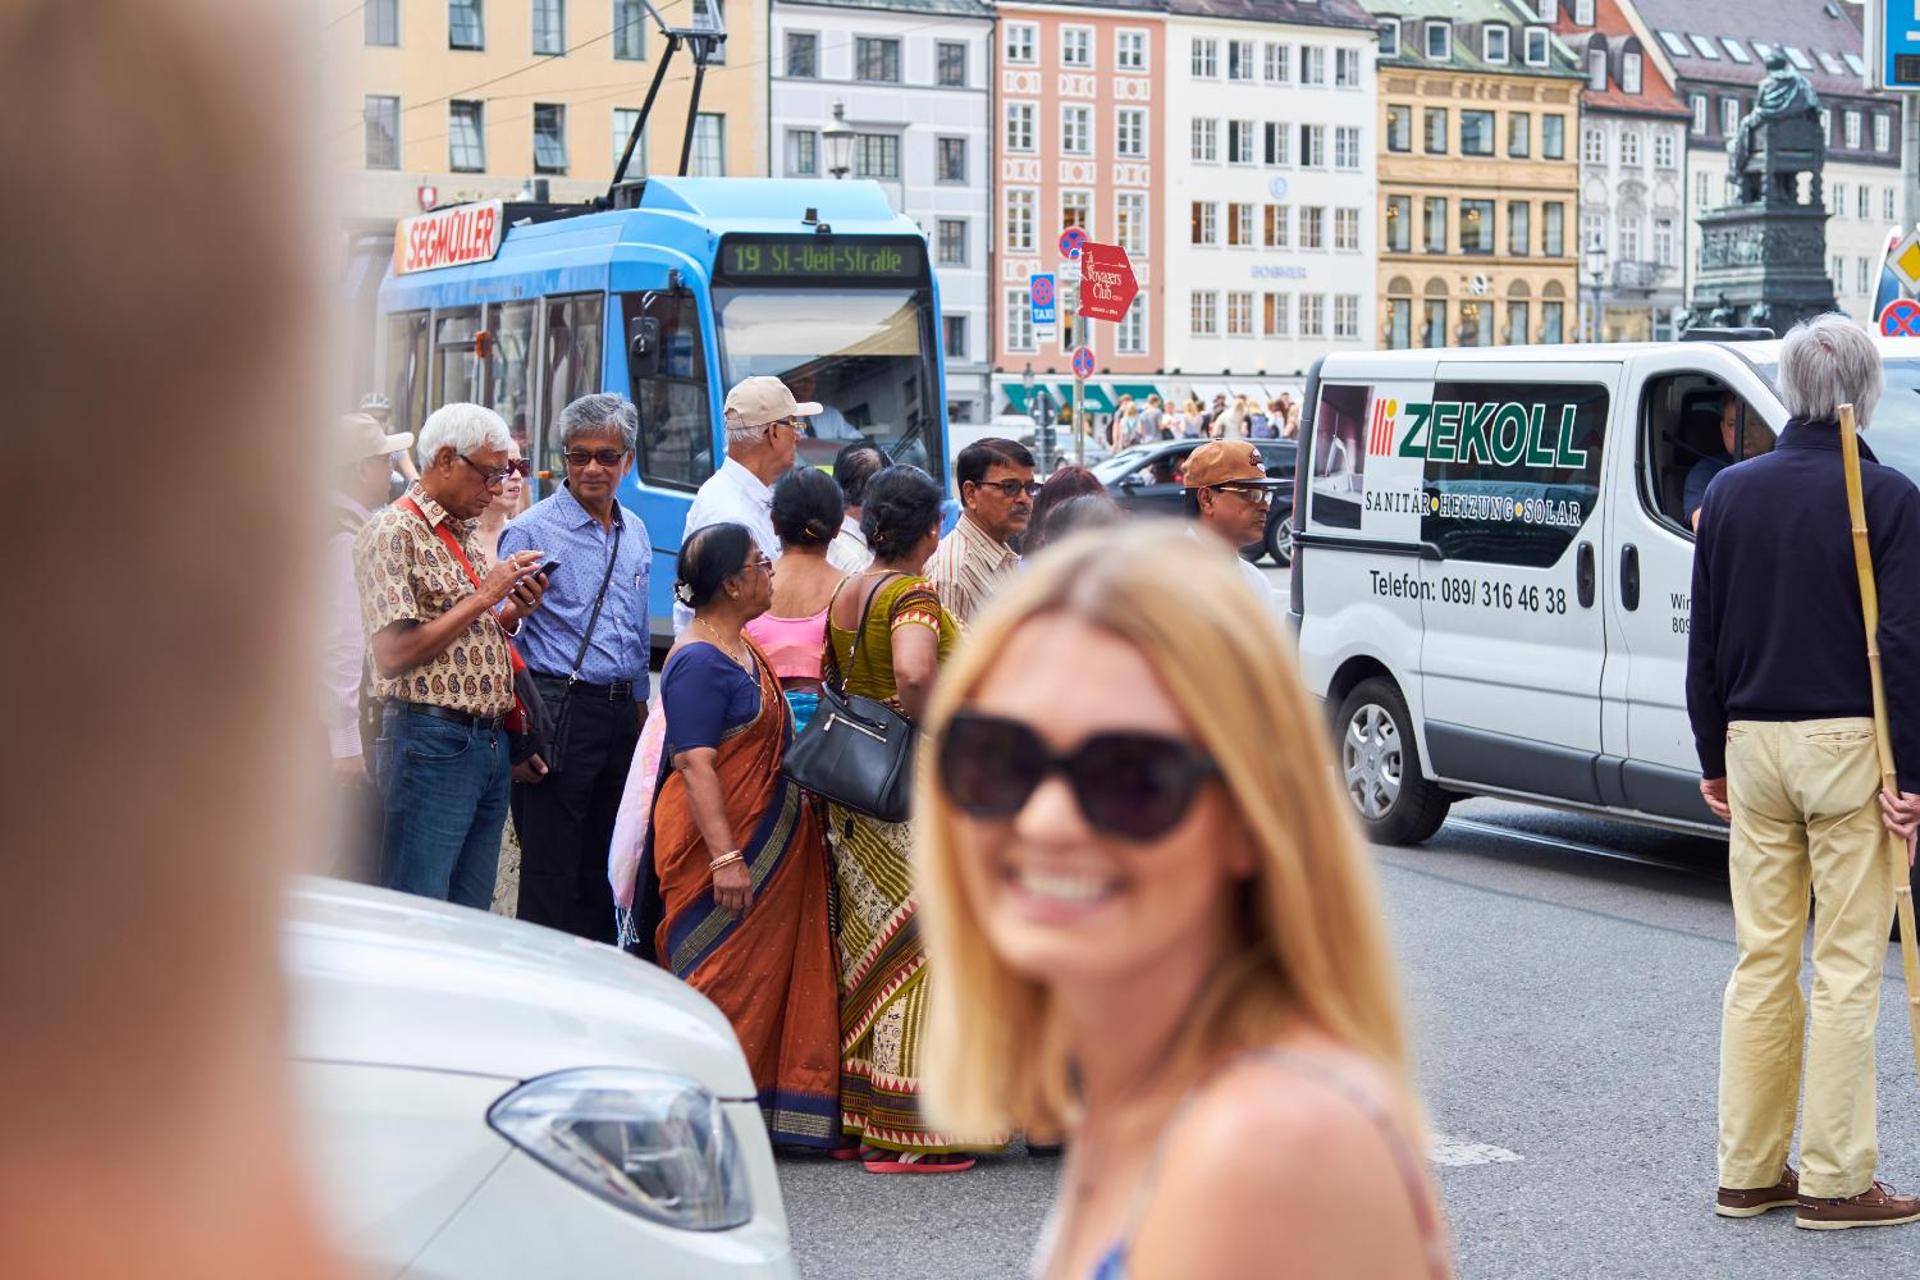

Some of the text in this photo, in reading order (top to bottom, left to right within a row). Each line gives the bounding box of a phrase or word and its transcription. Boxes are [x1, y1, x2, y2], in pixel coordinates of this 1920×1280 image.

[408, 207, 496, 269] SEGMÜLLER
[736, 246, 761, 271] 19
[1092, 282, 1112, 300] Club
[1033, 308, 1054, 320] TAXI
[1398, 401, 1588, 469] ZEKOLL
[1365, 487, 1582, 527] SANITÄR HEIZUNG SOLAR
[1370, 570, 1567, 615] Telefon: 089/ 316 46 38
